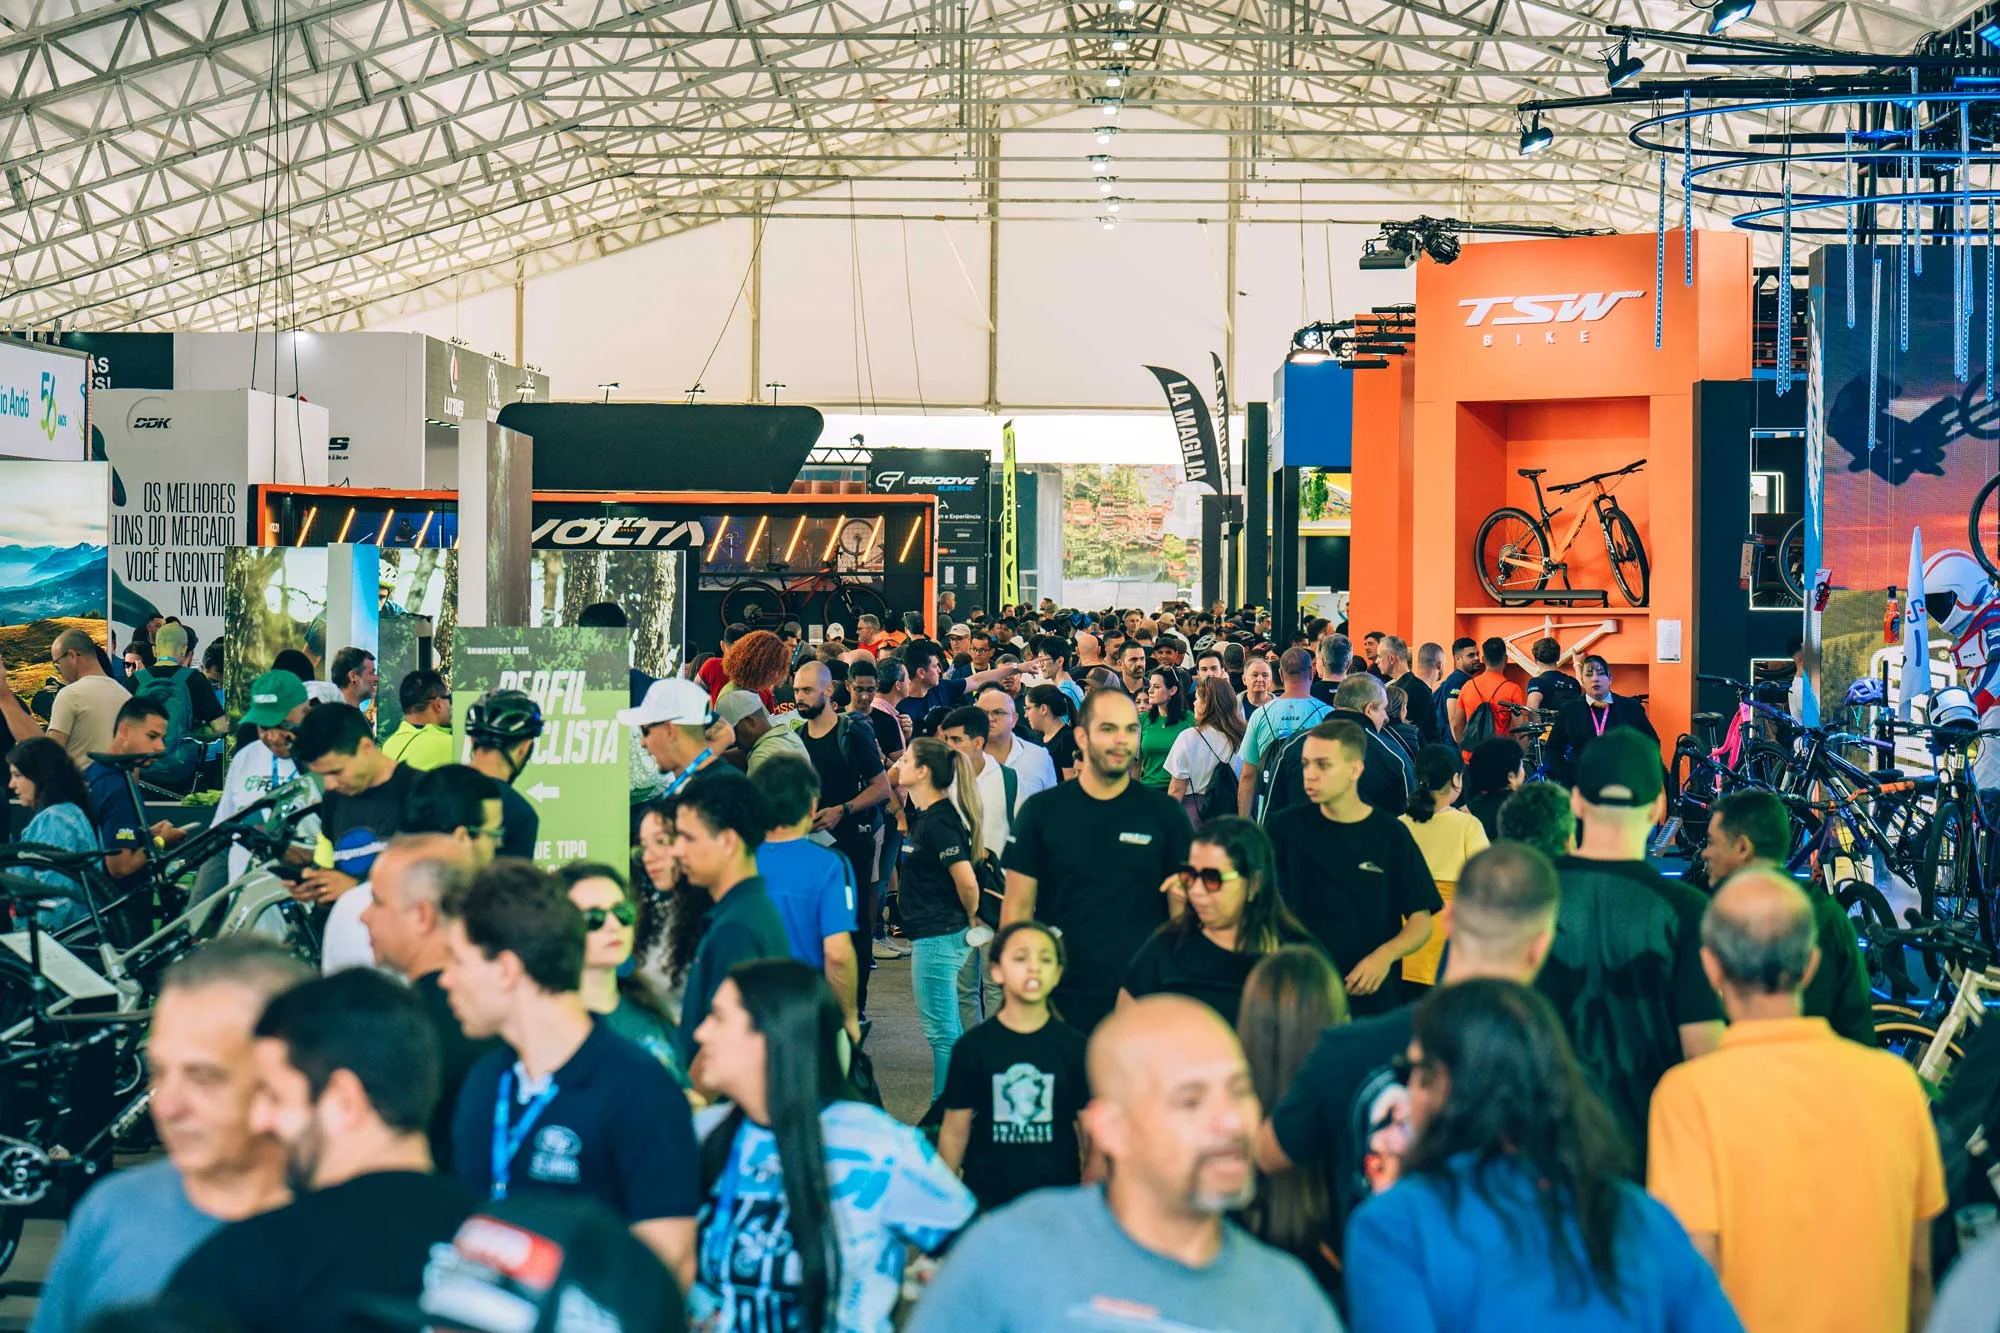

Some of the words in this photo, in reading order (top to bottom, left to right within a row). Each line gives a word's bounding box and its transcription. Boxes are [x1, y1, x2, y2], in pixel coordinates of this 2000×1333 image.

[1458, 290, 1648, 327] TSW
[1482, 330, 1590, 347] BIKE
[1167, 380, 1193, 408] LA
[133, 417, 172, 429] DDK
[1174, 408, 1208, 483] MAGLIA
[908, 476, 980, 485] GROOVE
[143, 482, 161, 513] OS
[166, 483, 236, 514] MELHORES
[112, 514, 143, 546] LINS
[149, 515, 166, 546] DO
[172, 516, 236, 547] MERCADO
[126, 546, 160, 582] VOCÊ
[181, 586, 199, 617] NA
[556, 839, 587, 859] TIPO
